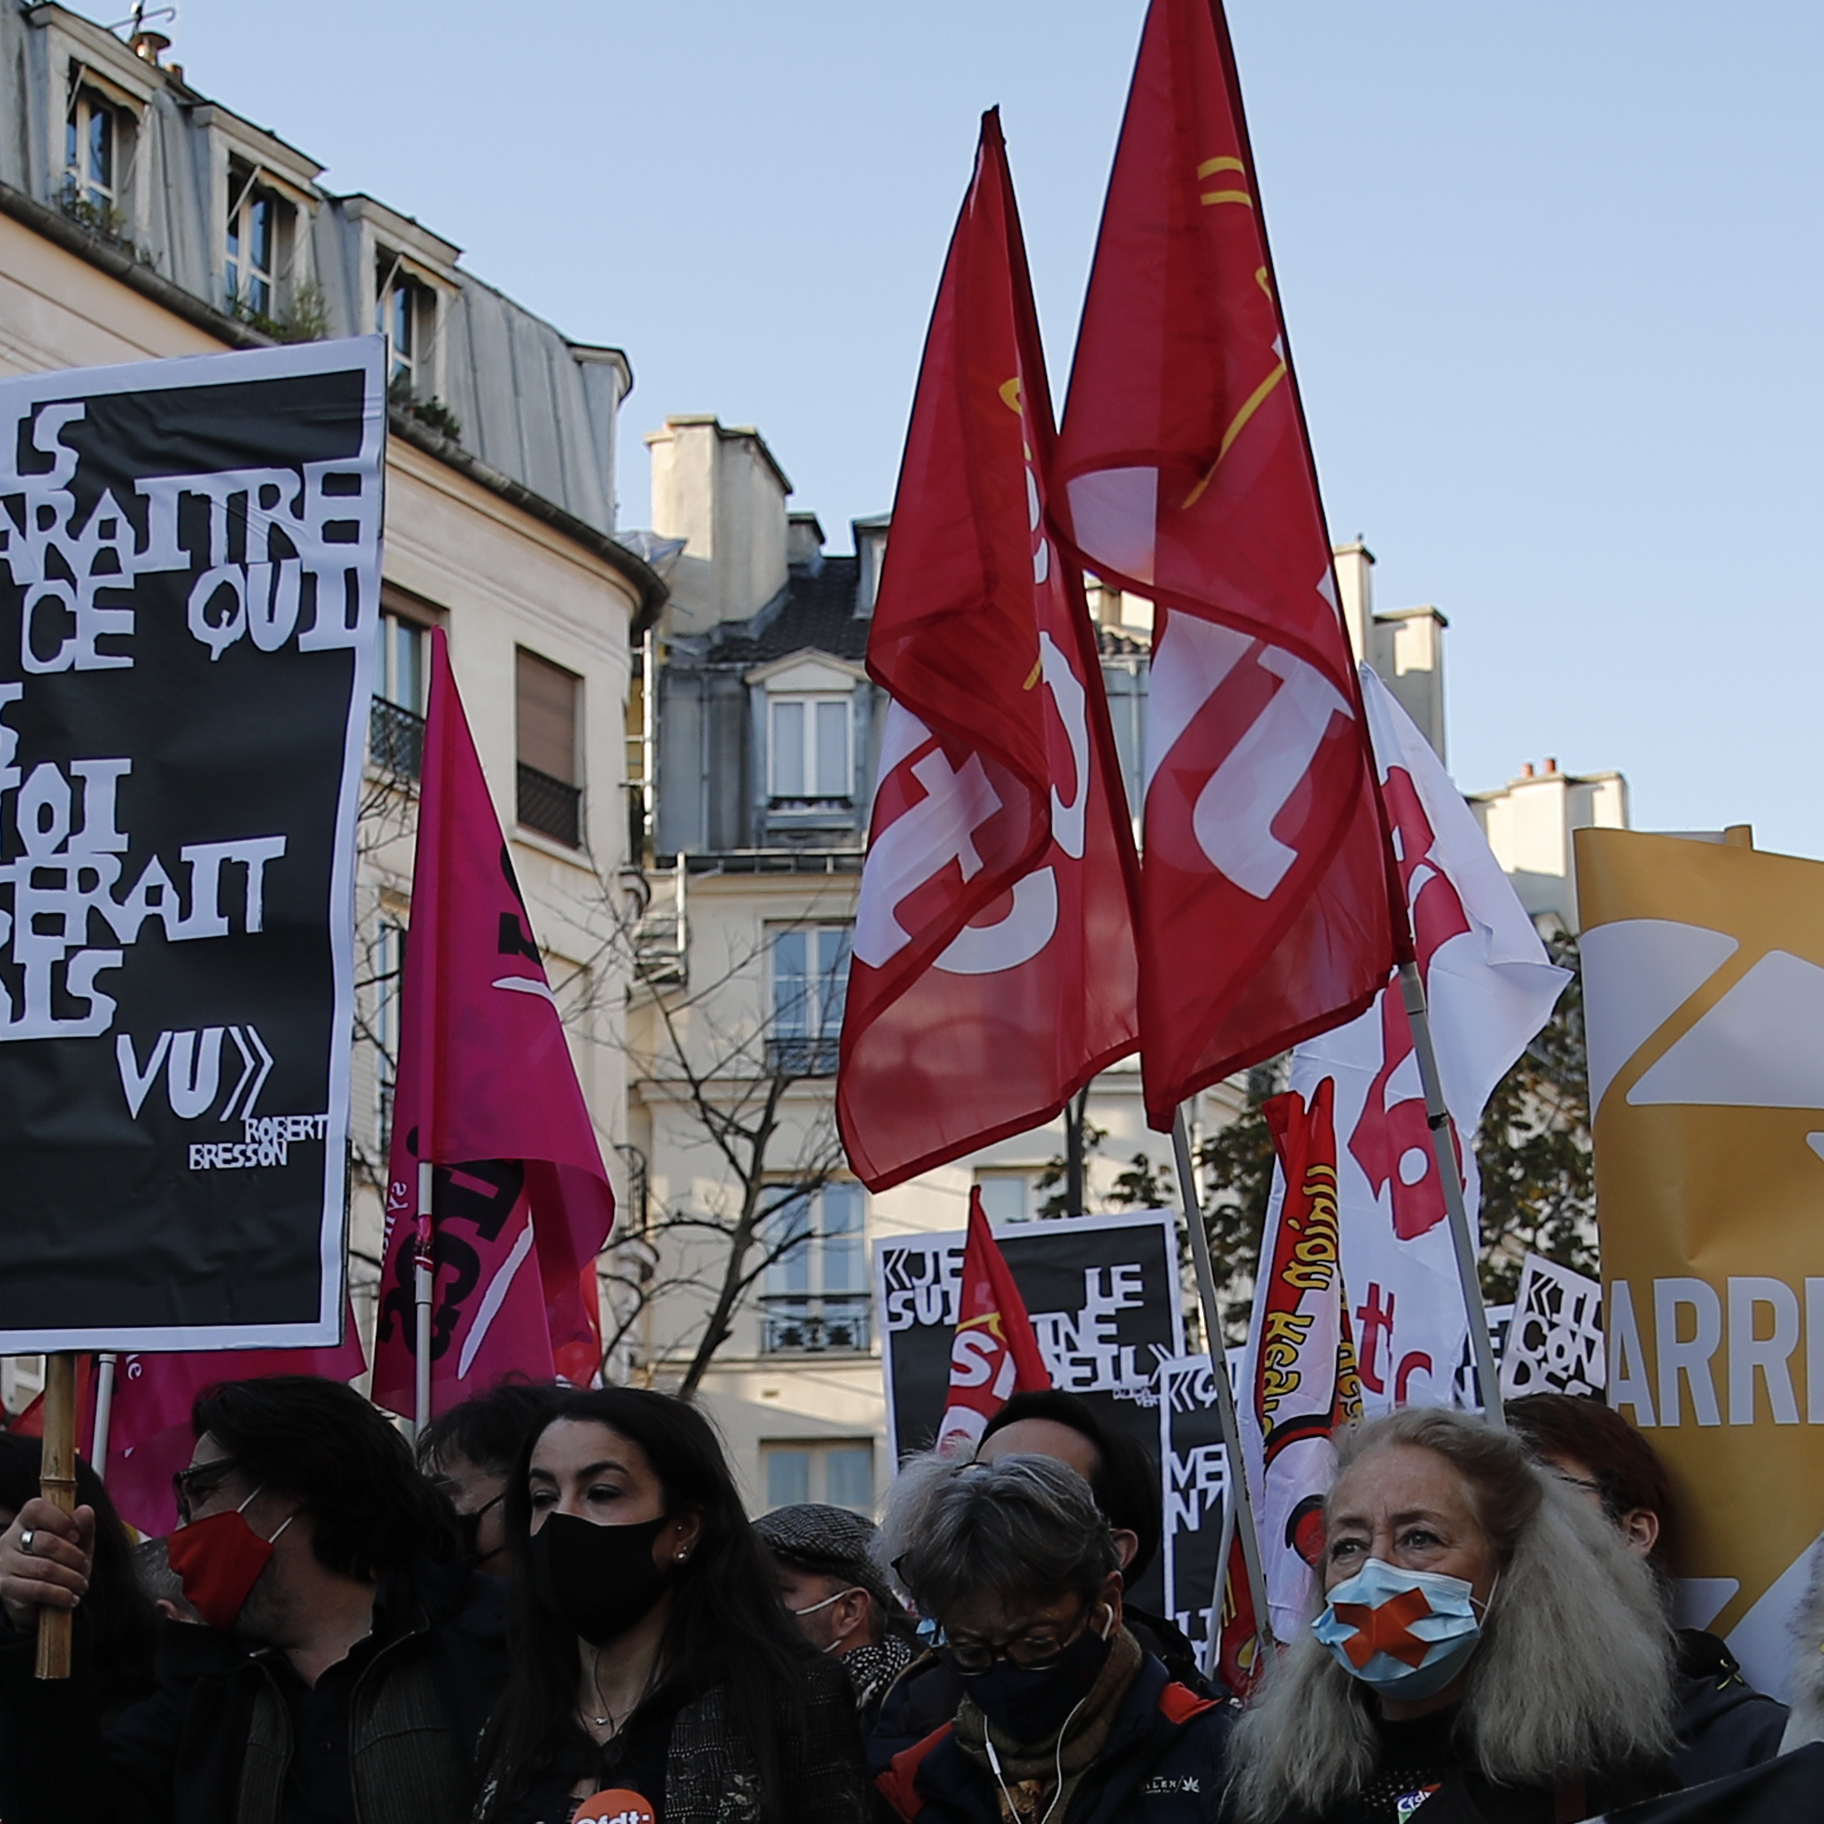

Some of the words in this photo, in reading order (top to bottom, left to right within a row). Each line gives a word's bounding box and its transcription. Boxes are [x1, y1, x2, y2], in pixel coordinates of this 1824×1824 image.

[21, 570, 134, 674] CE
[188, 558, 362, 660] QUI
[244, 1113, 328, 1144] ROBERT
[189, 1139, 288, 1170] BRESSON
[1083, 1263, 1144, 1309] LE
